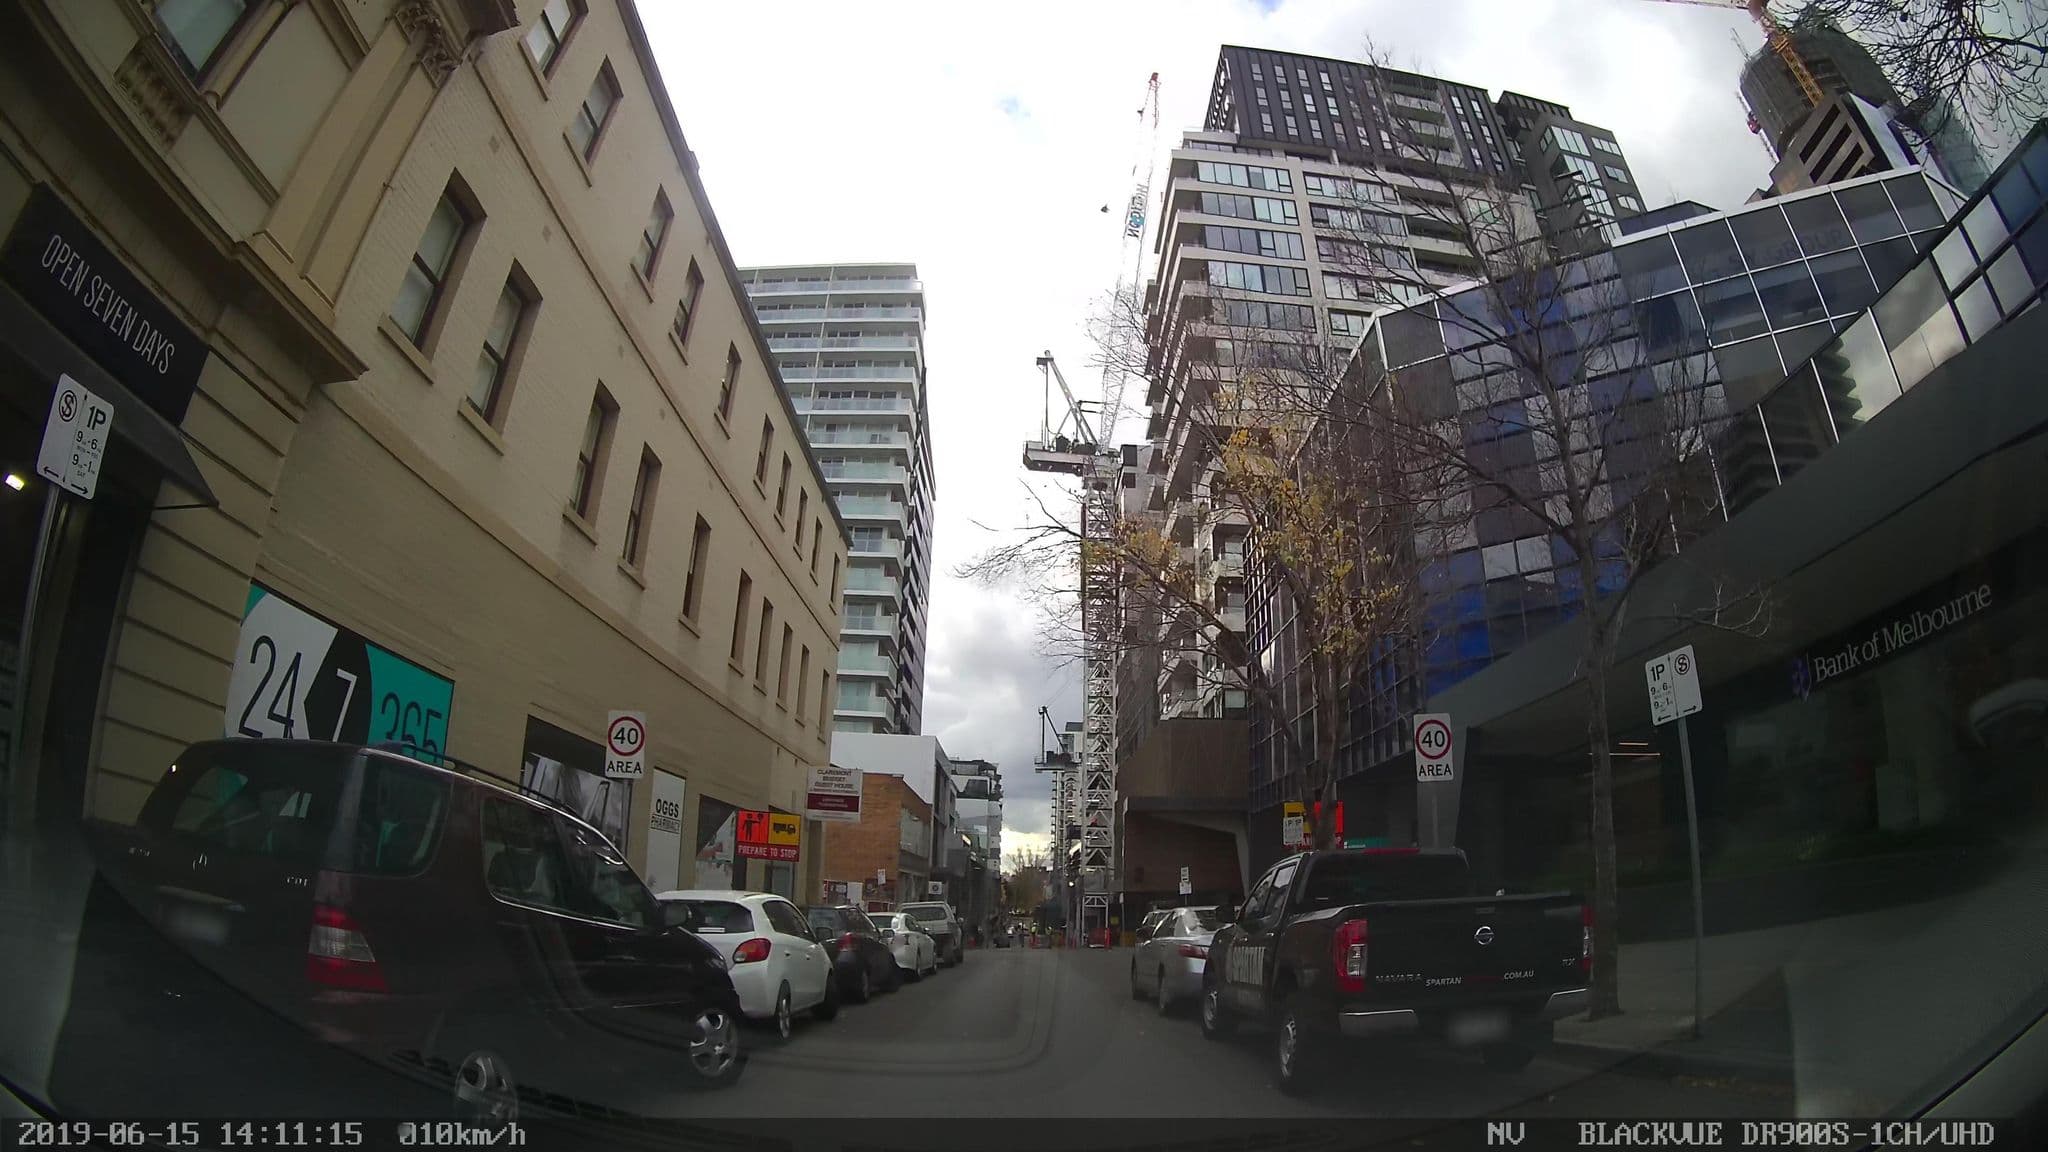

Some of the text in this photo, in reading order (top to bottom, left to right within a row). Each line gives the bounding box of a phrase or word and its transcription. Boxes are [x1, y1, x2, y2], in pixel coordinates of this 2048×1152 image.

[41, 234, 176, 375] OPEN SEVEN DAYS
[86, 406, 107, 431] 1P
[1813, 584, 1993, 683] Bank of Melbourne
[1650, 663, 1665, 682] 1P
[239, 634, 302, 741] 24
[331, 667, 358, 743] 7
[613, 727, 639, 745] 40
[1421, 730, 1446, 748] 40
[606, 760, 643, 774] AREA
[1418, 764, 1452, 778] AREA
[655, 798, 680, 819] OGGS
[737, 845, 797, 859] PREPARE TO STOP
[1375, 973, 1423, 984] NAVARA
[1425, 976, 1462, 987] SPARTAN
